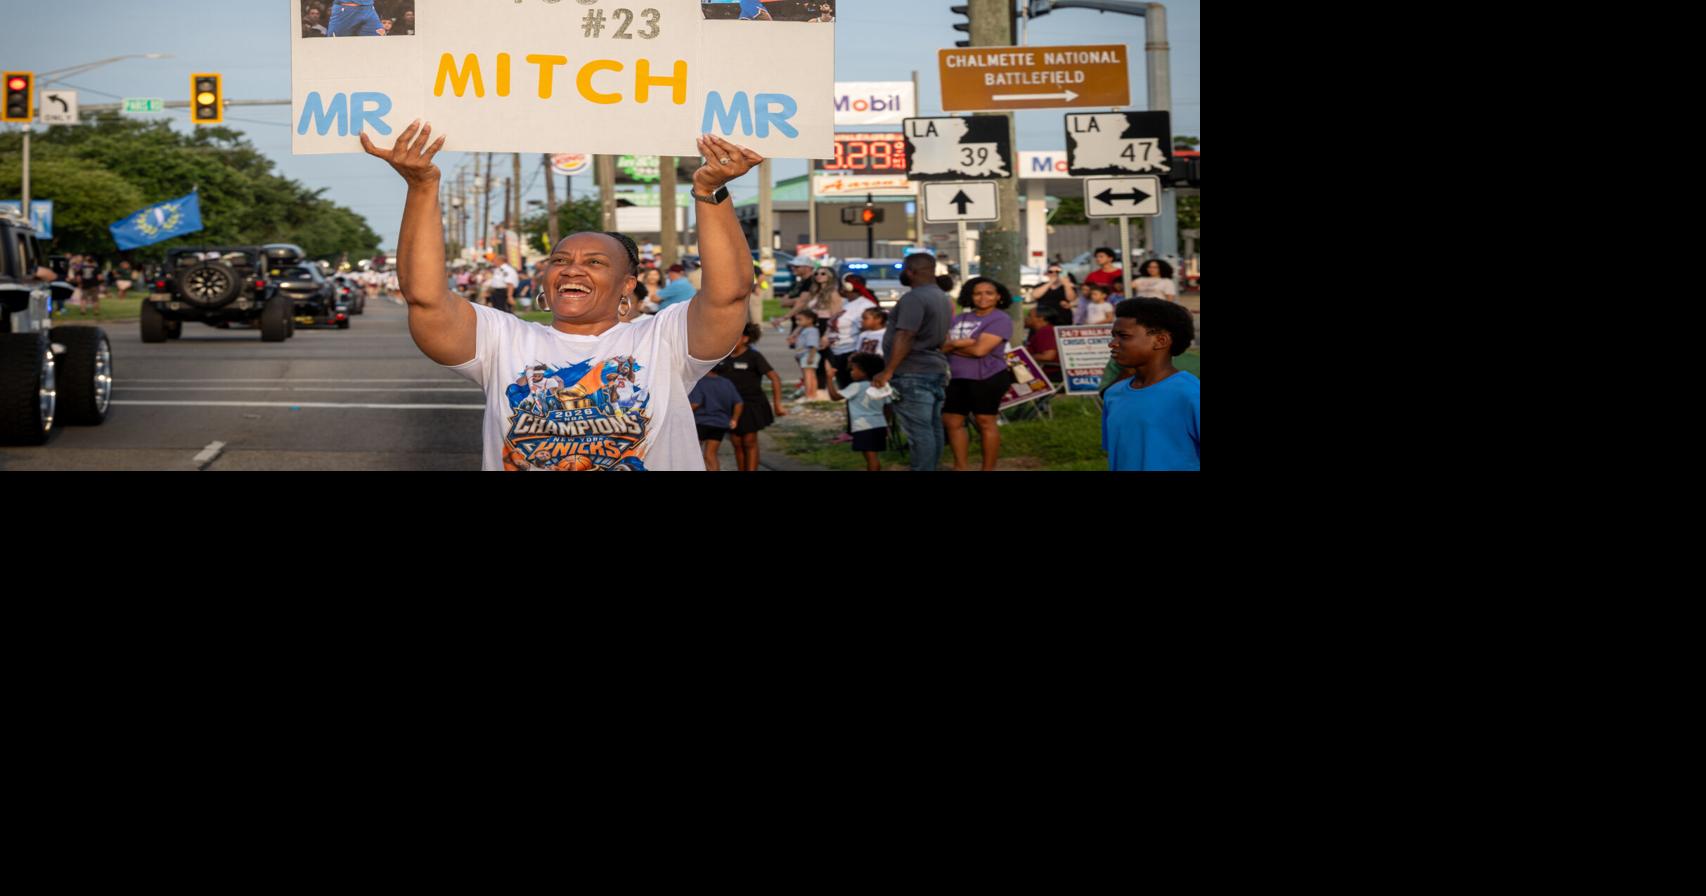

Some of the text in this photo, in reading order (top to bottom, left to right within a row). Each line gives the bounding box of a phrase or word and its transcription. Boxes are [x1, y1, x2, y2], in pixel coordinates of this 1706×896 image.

[581, 8, 661, 40] #23
[945, 51, 1121, 68] CHALMETTE NATIONAL
[433, 52, 688, 105] MITCH
[984, 71, 1085, 86] BATTLEFIELD
[834, 95, 901, 112] Mobil
[44, 114, 73, 122] ONLY
[297, 91, 392, 136] MR
[702, 91, 799, 138] MR
[912, 120, 939, 138] LA
[1074, 116, 1101, 133] LA
[960, 147, 989, 167] 39
[1120, 142, 1153, 162] 47
[1072, 377, 1096, 385] CALL
[555, 408, 593, 418] 2026
[513, 413, 642, 435] CHAMPIONS
[528, 440, 621, 459] KNICKS
